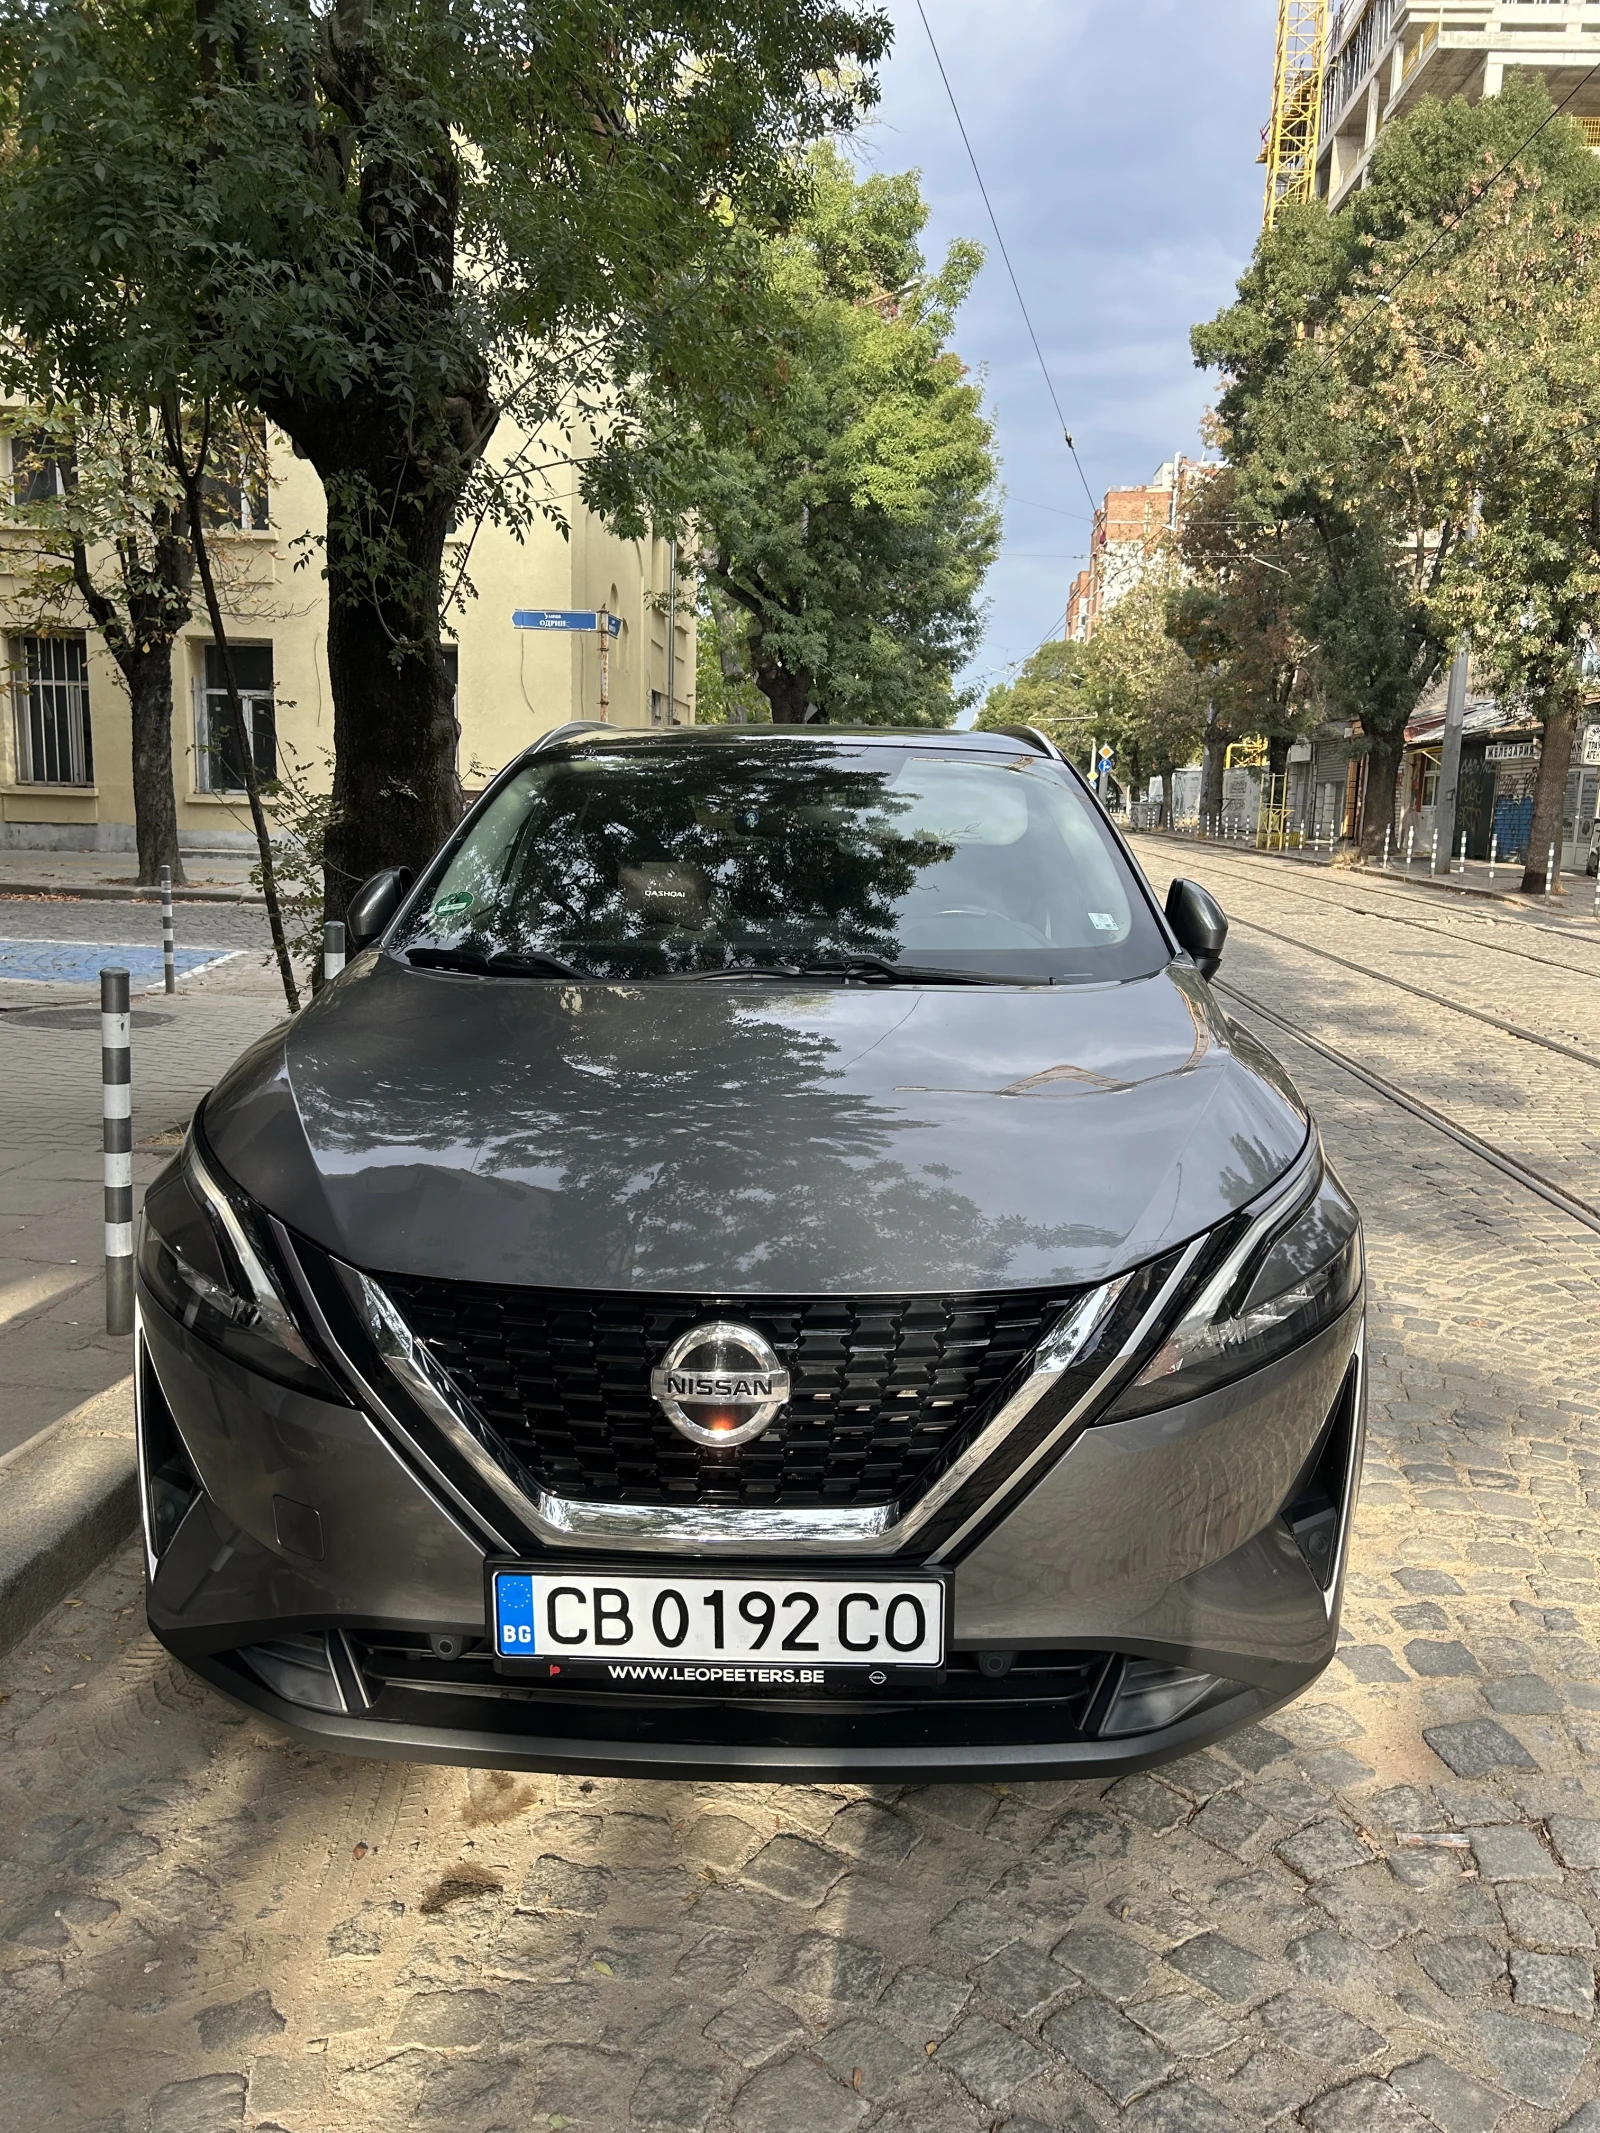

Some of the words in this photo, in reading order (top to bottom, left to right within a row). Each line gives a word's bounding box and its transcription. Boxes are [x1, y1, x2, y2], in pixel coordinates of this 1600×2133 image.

[1487, 745, 1533, 758] ЖЕЛЕЗАРИЯ
[644, 890, 686, 898] QASHQAI
[667, 1377, 773, 1396] NISSAN
[547, 1586, 634, 1646] CB
[652, 1588, 820, 1652] 0192
[837, 1592, 927, 1652] CO
[502, 1624, 532, 1644] BG
[607, 1665, 825, 1684] WWW.LEOPEETERS.BE
